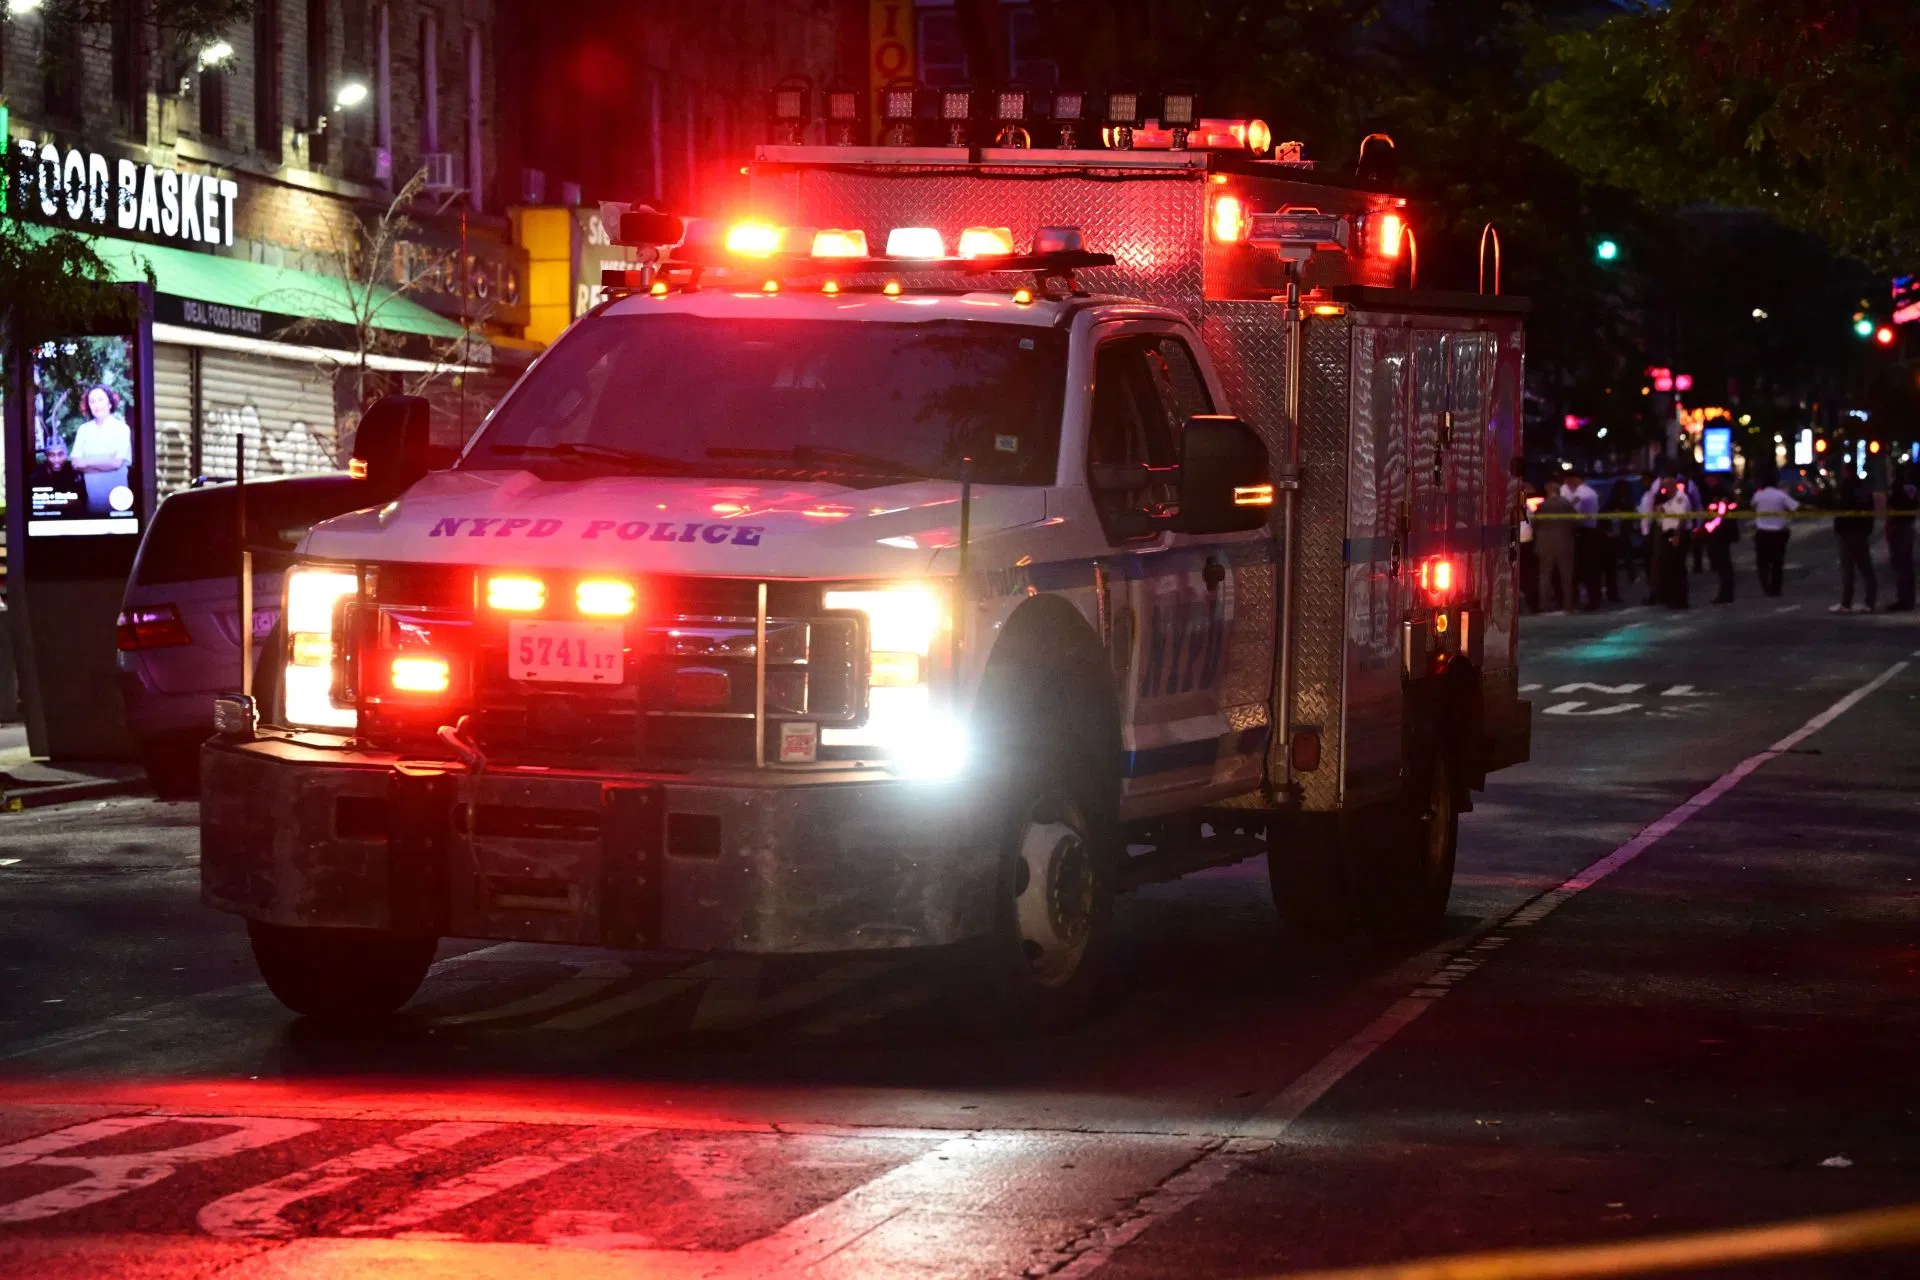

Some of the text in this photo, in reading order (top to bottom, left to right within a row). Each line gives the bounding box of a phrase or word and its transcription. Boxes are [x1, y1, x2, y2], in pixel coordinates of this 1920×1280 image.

[18, 139, 238, 247] FOOD BASKET
[182, 300, 262, 333] IDEAL FOOD BASKET
[428, 516, 766, 547] NYPD POLICE
[518, 635, 616, 669] 5741 17
